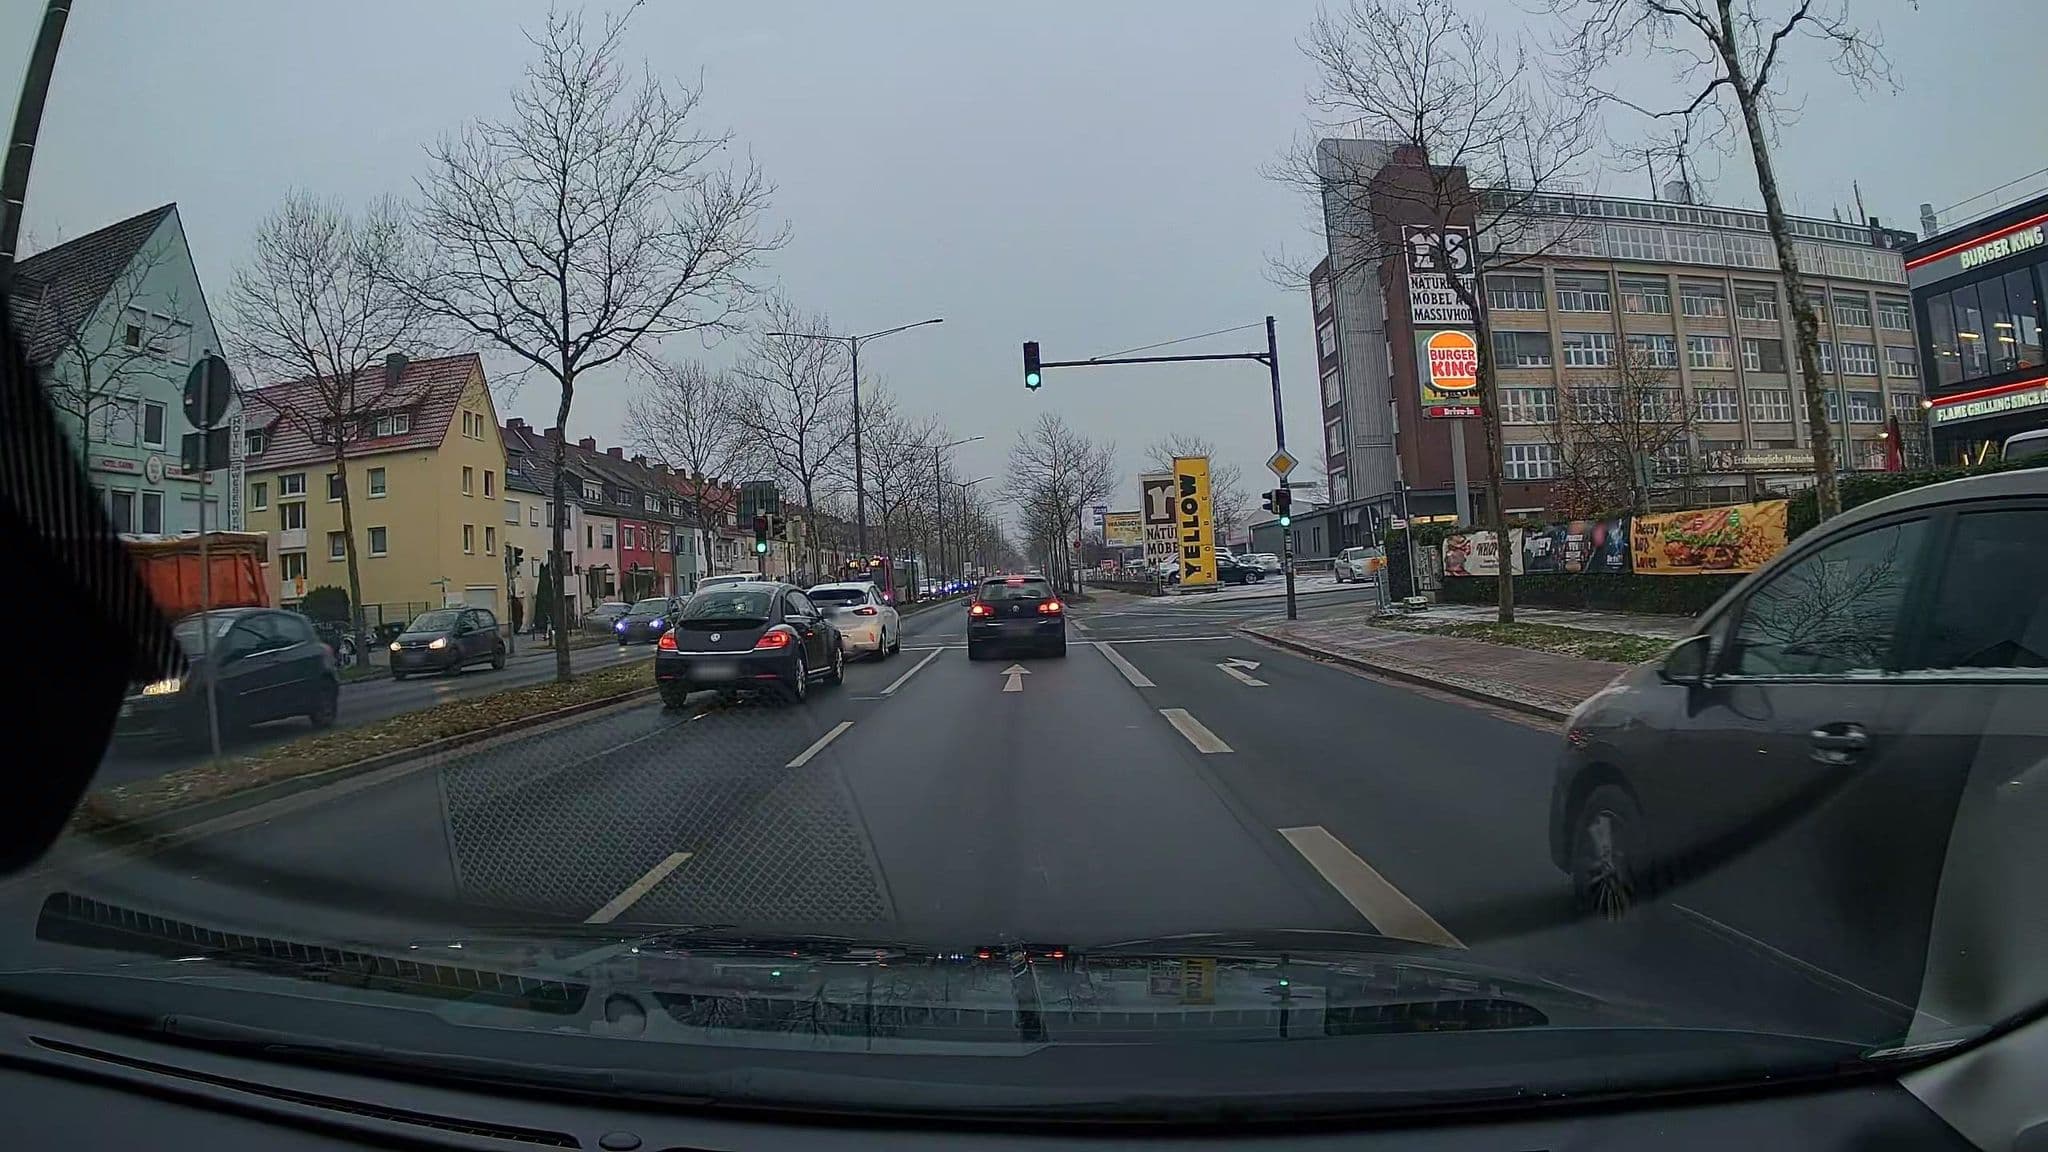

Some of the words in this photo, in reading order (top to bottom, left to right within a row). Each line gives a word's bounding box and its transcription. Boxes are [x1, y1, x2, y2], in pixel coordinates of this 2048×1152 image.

[1960, 238, 2010, 269] BURGER
[2009, 226, 2043, 252] KING
[1430, 349, 1475, 360] BURGER
[1432, 361, 1476, 377] KING
[1937, 405, 1967, 422] FLAME
[1967, 396, 2010, 416] GRILLING
[2011, 391, 2040, 409] SINCE
[1179, 474, 1202, 579] YELLOW
[1147, 540, 1178, 554] MÖBE
